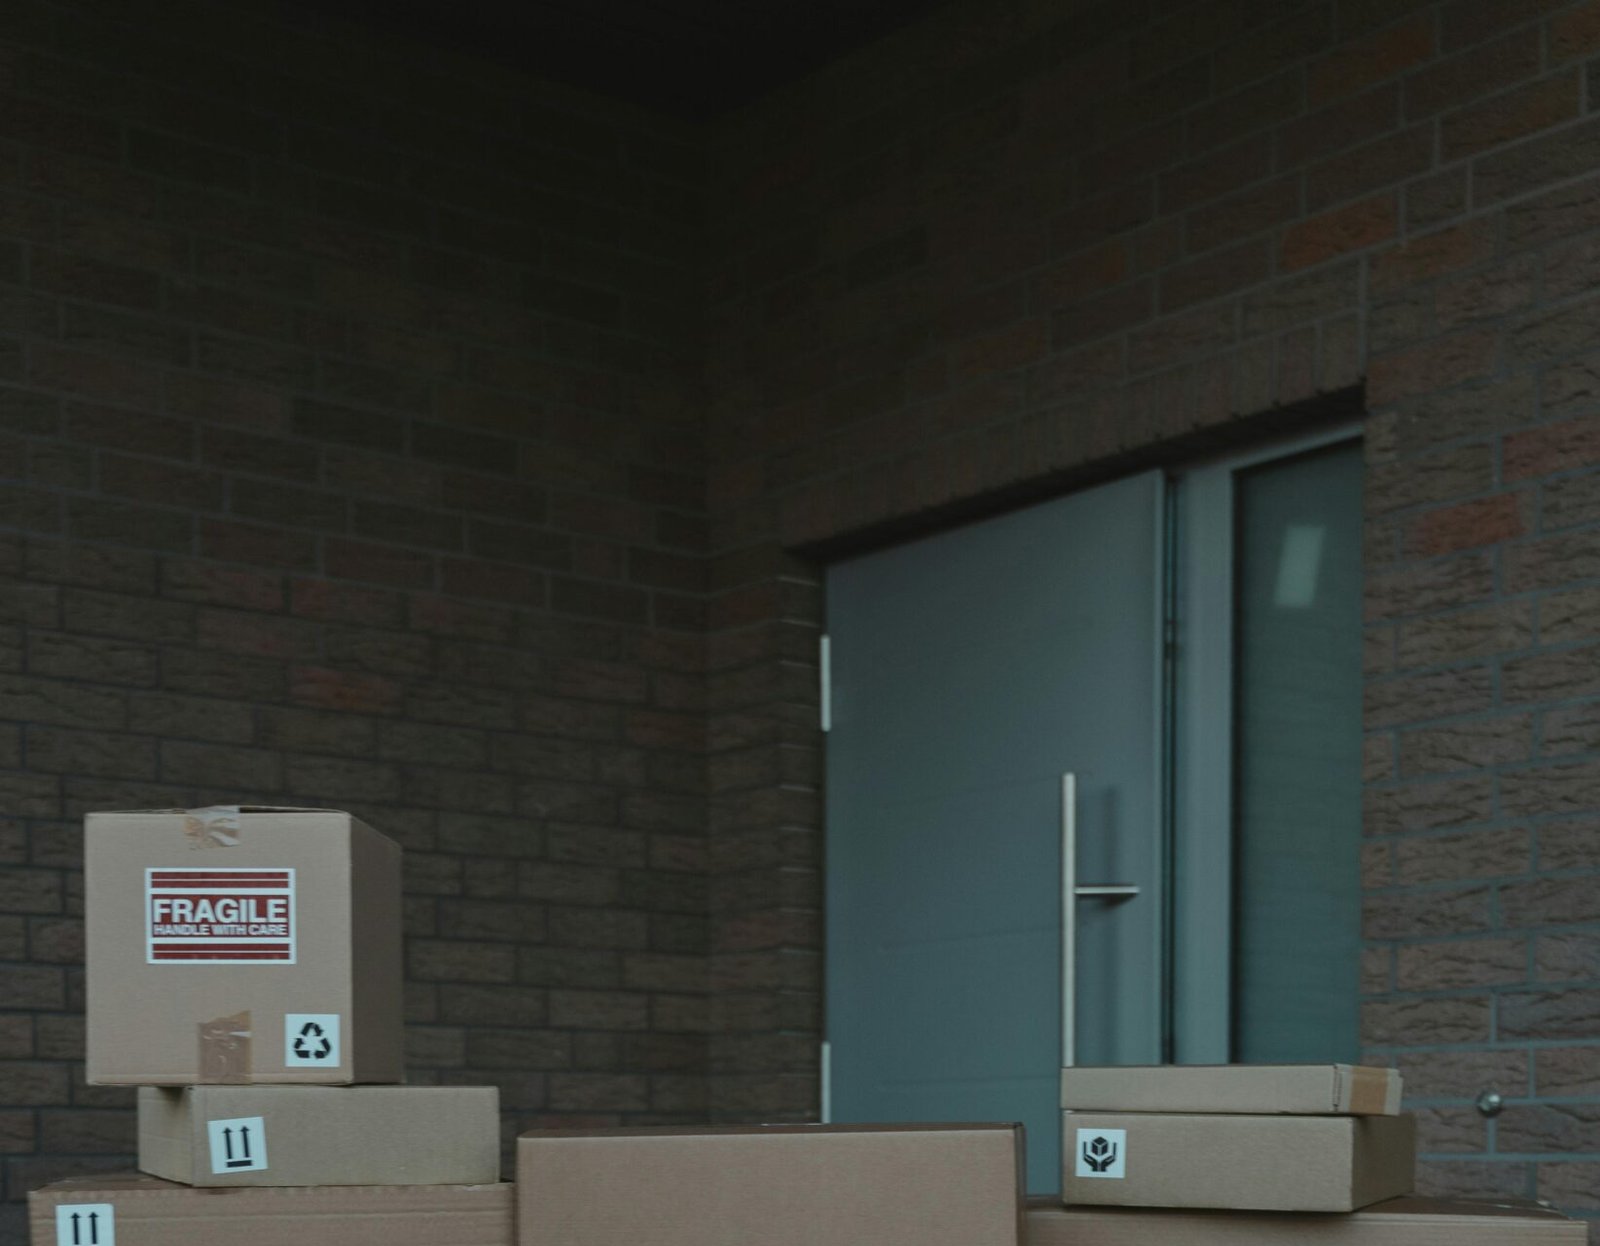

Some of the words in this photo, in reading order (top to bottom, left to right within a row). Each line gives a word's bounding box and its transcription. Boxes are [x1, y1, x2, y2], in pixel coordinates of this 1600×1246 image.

[153, 898, 287, 923] FRAGILE
[154, 924, 211, 935] HANDLE
[212, 924, 247, 935] WITH
[248, 924, 287, 935] CARE
